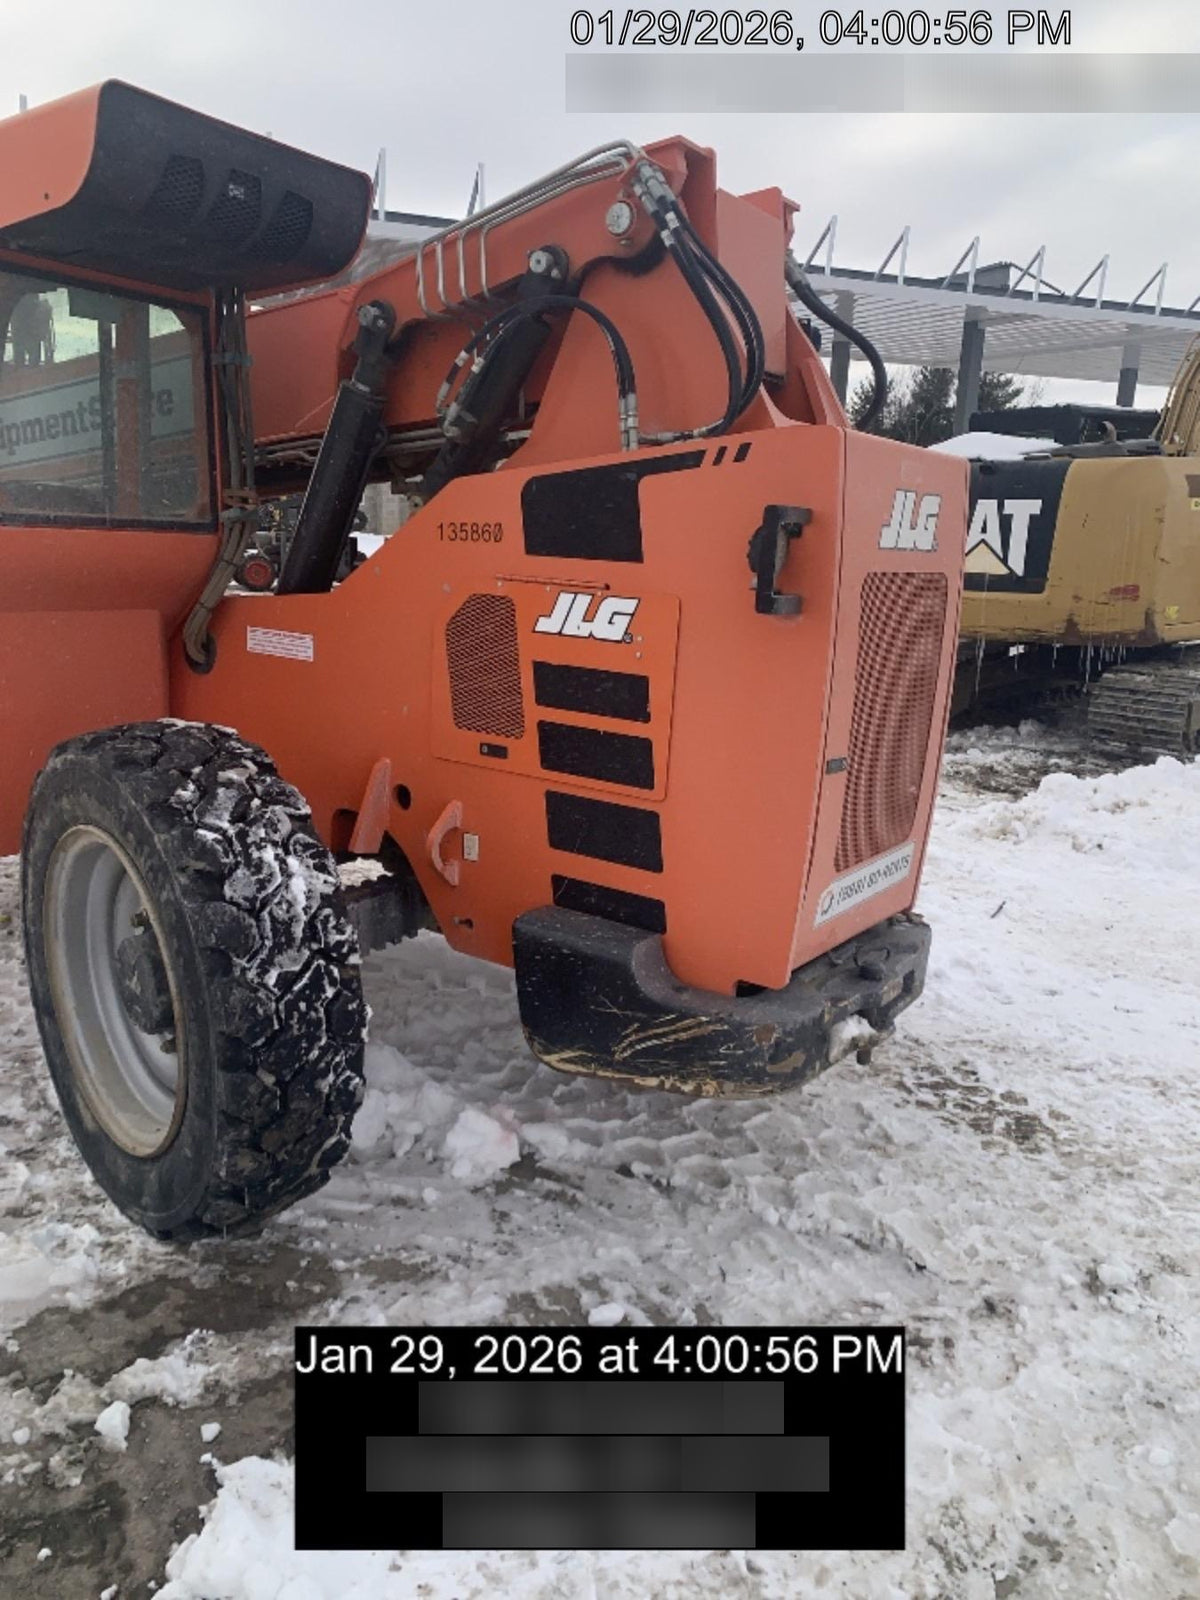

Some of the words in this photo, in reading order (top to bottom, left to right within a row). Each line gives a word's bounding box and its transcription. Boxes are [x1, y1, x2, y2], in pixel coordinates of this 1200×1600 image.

[437, 522, 503, 543] 135860
[879, 488, 941, 552] JLG
[965, 499, 1042, 577] AT
[533, 591, 640, 643] JLG
